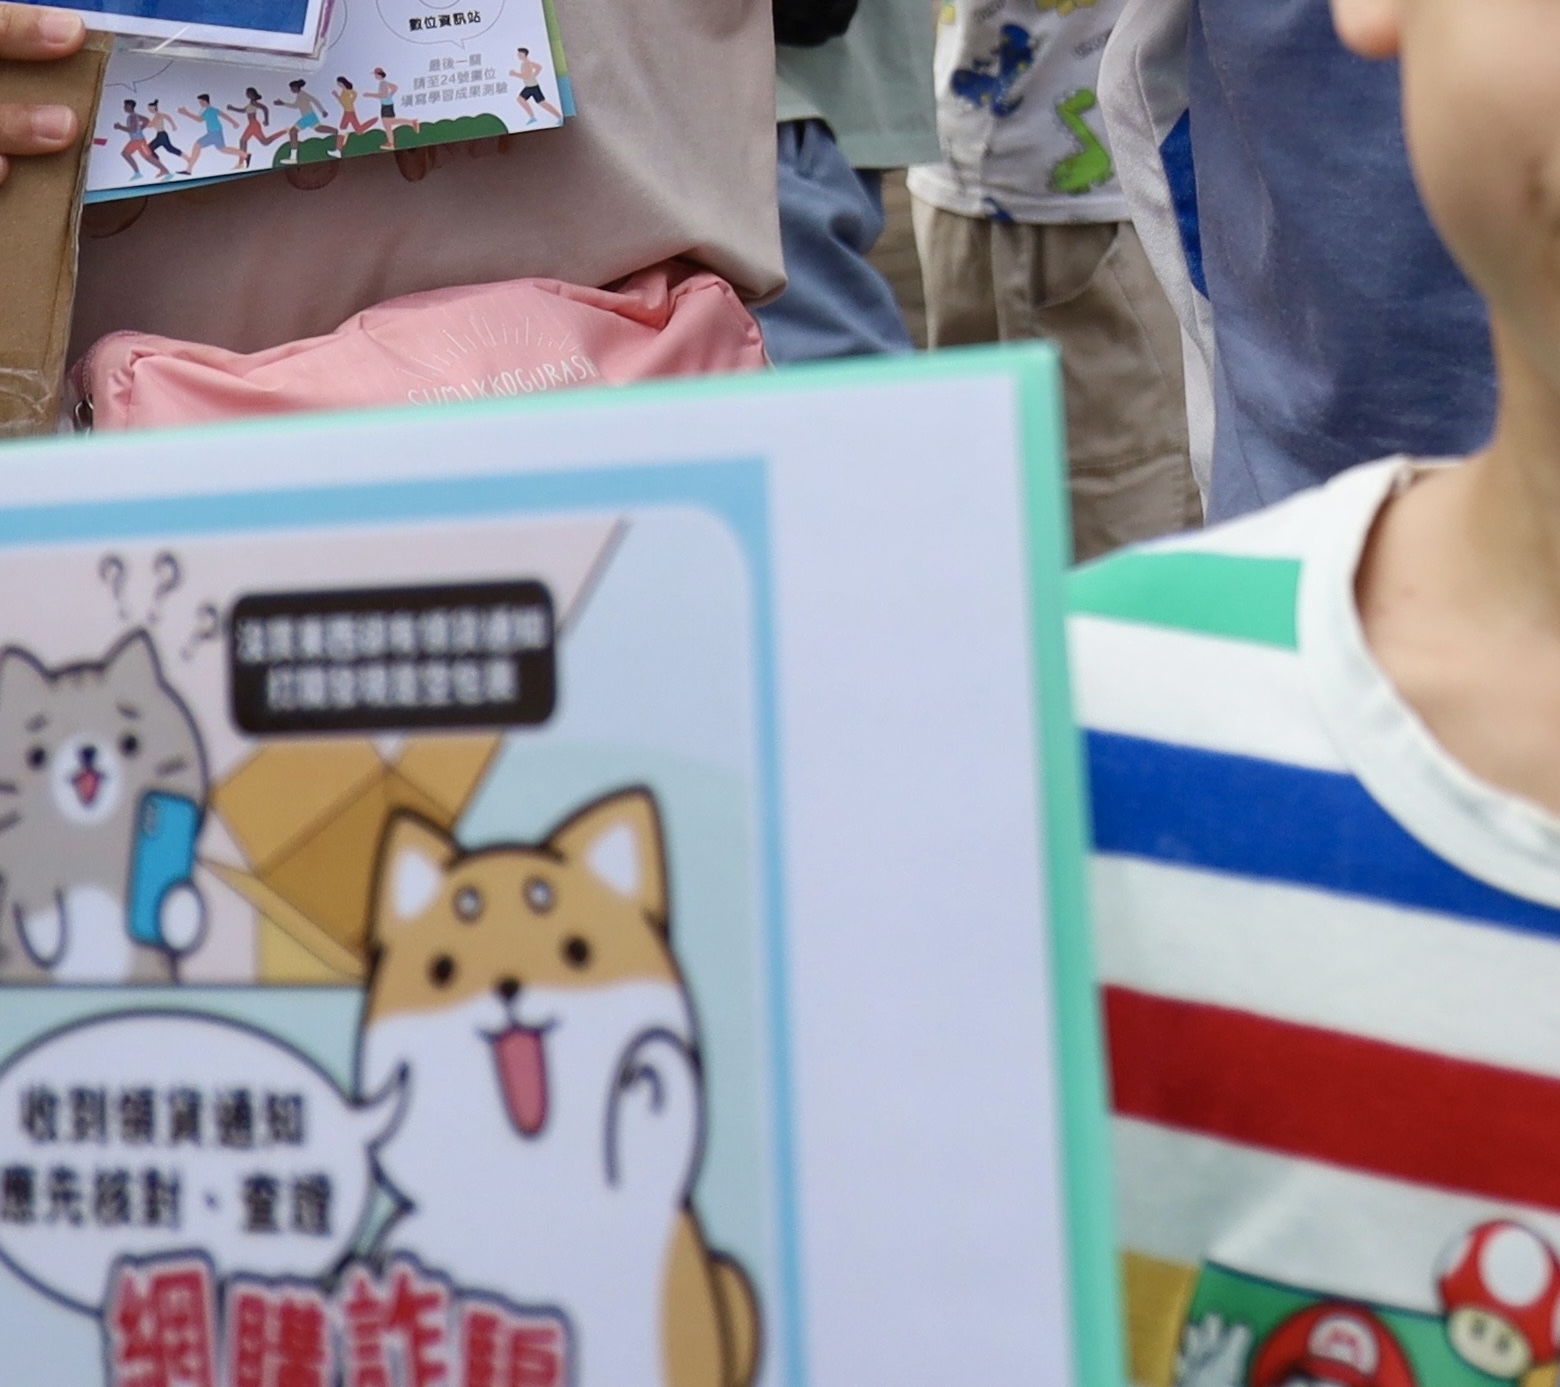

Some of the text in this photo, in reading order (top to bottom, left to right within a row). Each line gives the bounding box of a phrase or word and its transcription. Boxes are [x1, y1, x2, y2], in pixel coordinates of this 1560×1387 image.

[408, 10, 482, 32] 數位資訊站
[19, 1083, 307, 1148] 收到領貨通知
